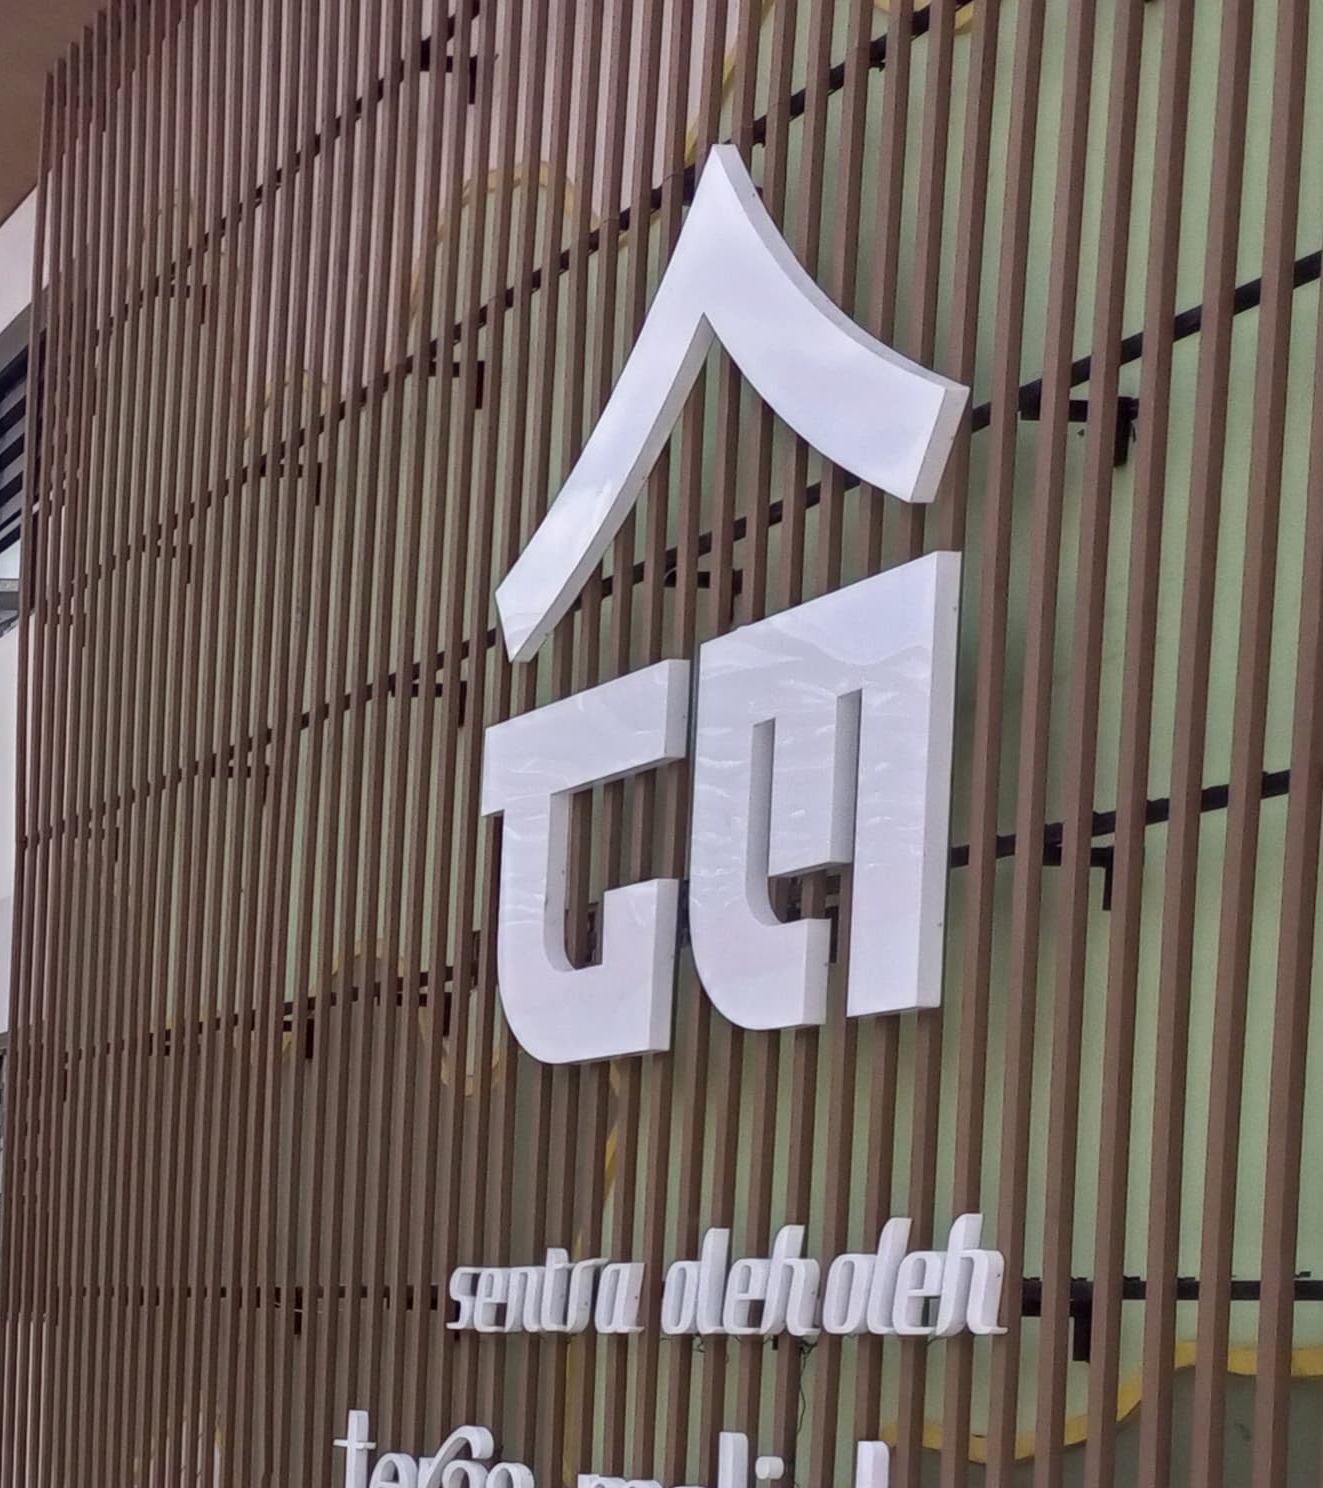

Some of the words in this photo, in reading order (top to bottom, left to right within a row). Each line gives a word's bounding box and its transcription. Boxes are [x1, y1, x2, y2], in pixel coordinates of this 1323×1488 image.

[446, 1246, 645, 1334] sentra
[660, 1226, 821, 1337] oleh
[822, 1212, 1009, 1337] oleh
